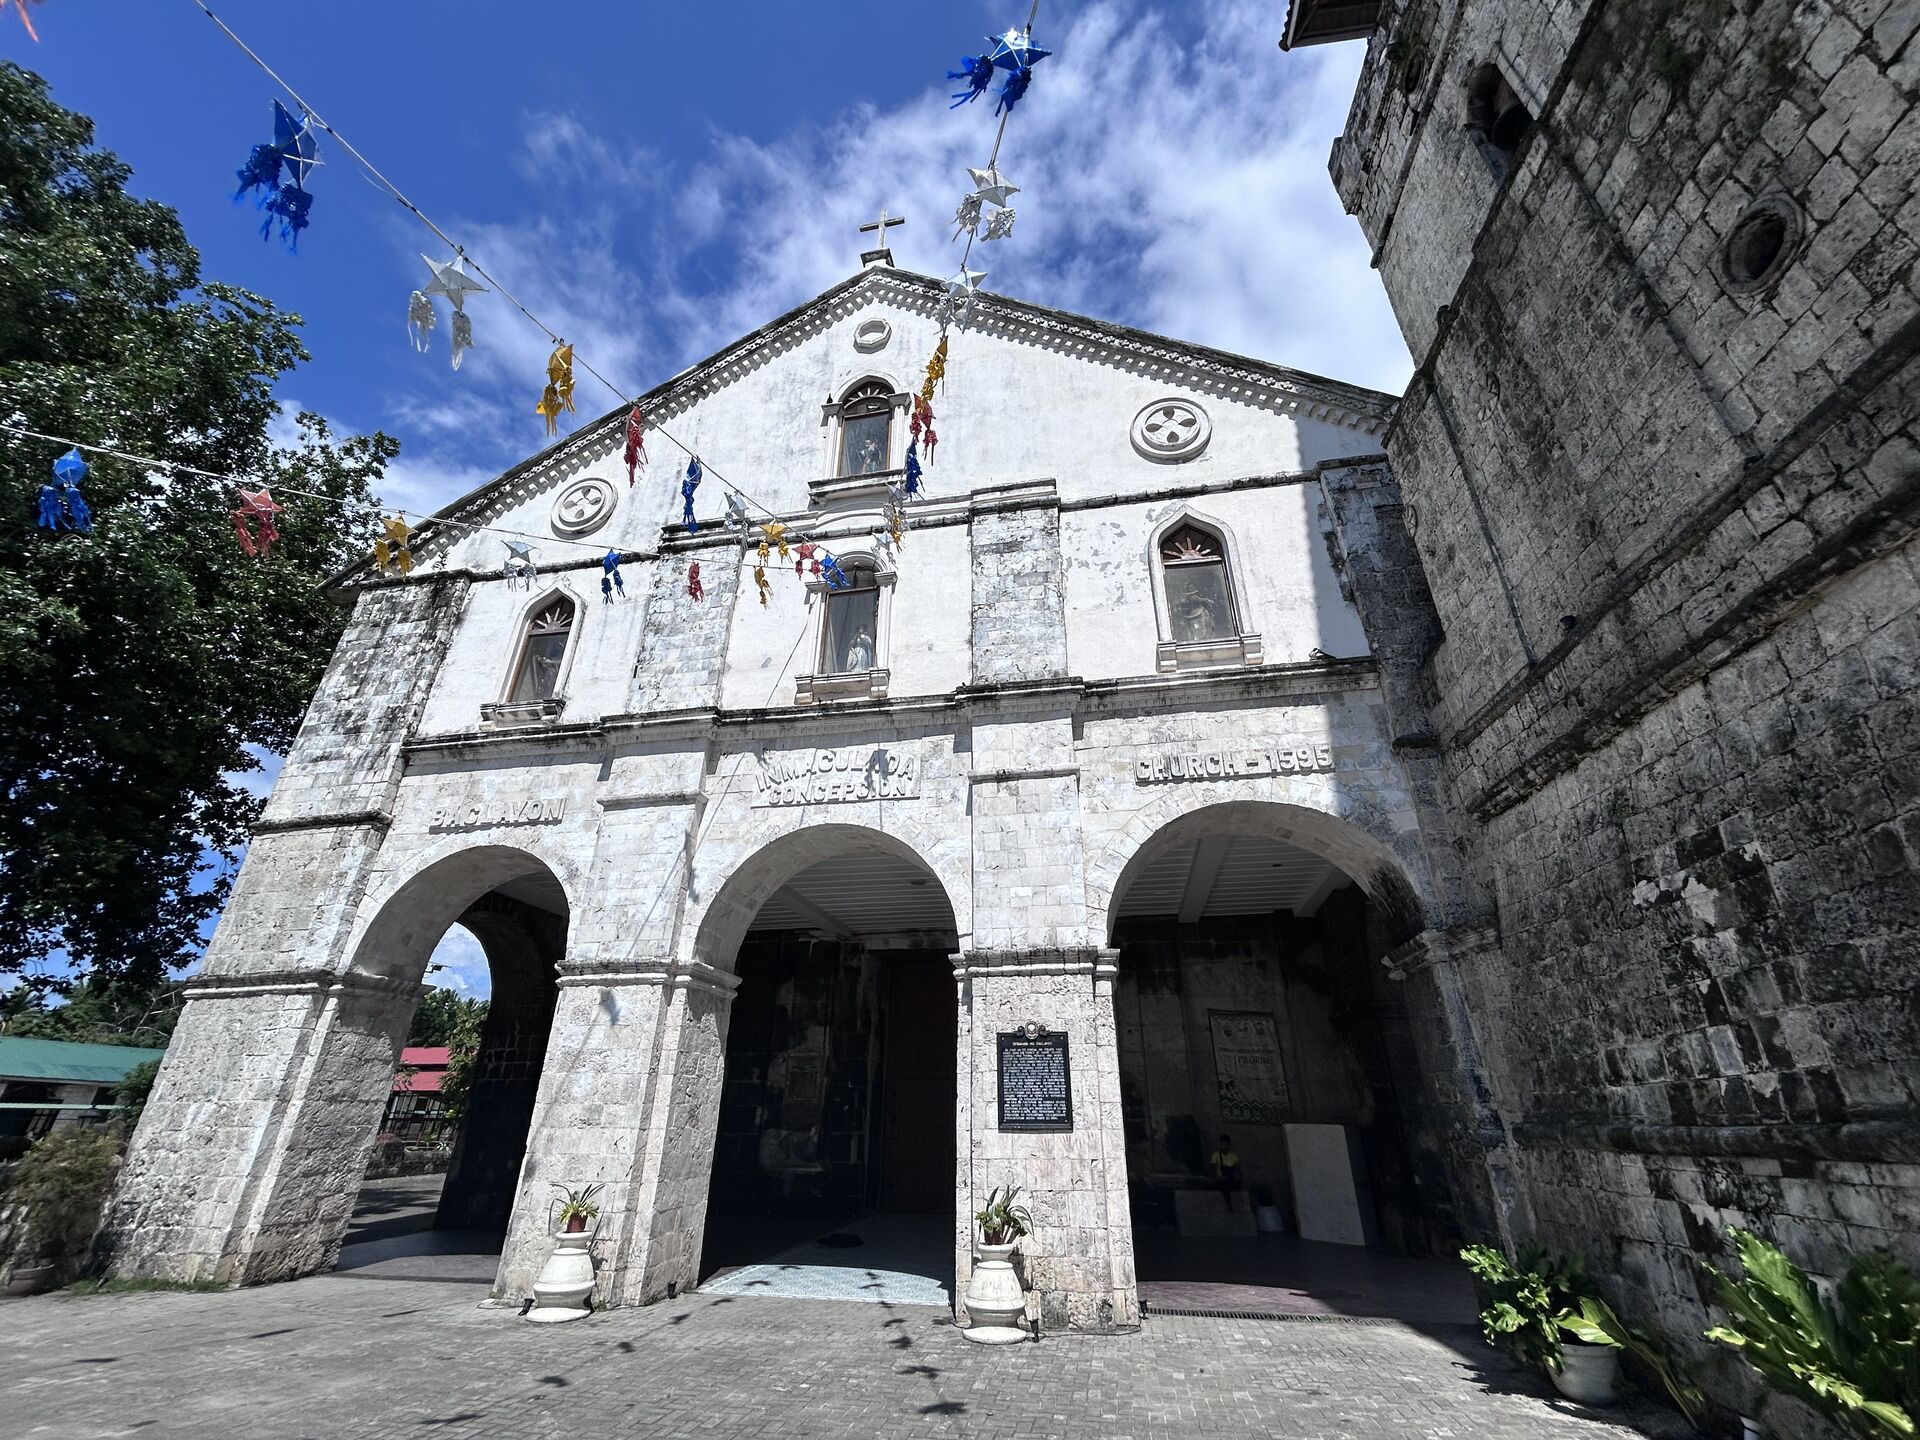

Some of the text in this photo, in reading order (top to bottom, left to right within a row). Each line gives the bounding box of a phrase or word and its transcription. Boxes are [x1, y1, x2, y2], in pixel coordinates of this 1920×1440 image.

[1135, 750, 1240, 782] CHURCH
[1264, 744, 1334, 773] 1595
[429, 797, 567, 829] BACLAYON
